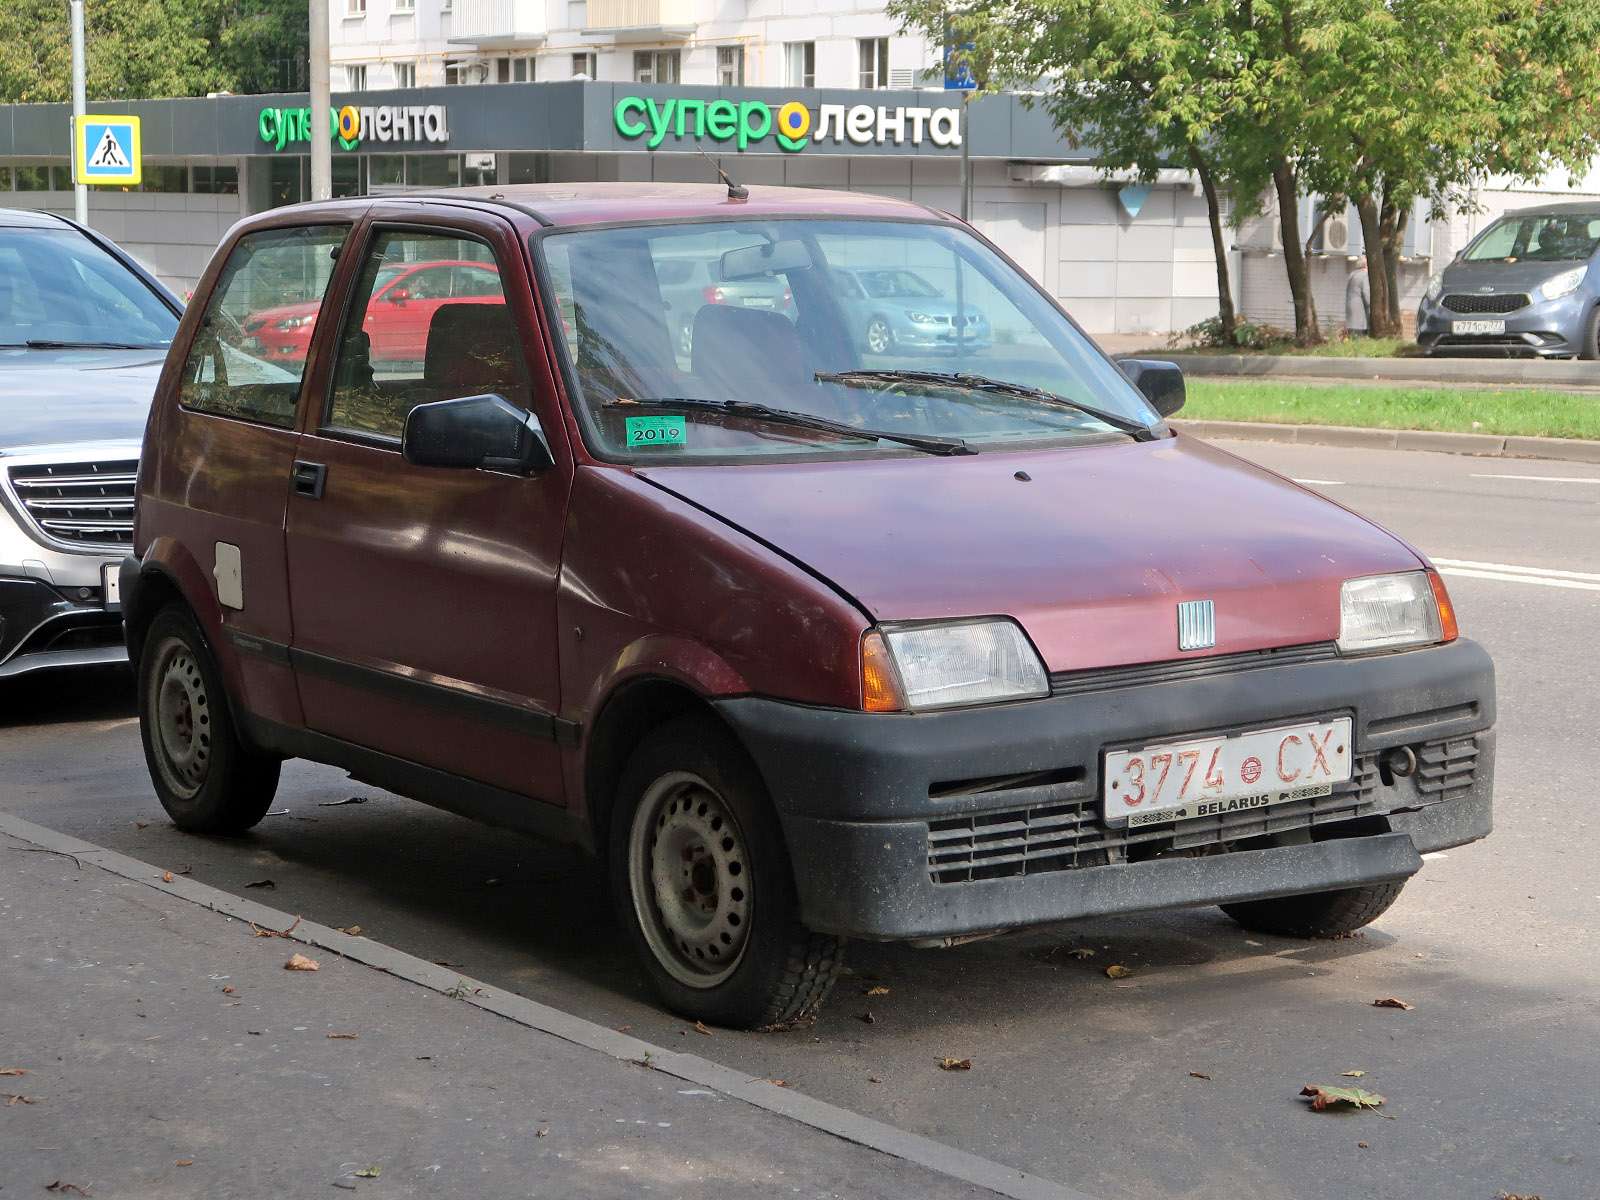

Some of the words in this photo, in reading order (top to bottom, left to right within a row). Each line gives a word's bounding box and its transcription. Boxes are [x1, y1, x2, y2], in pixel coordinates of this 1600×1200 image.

[359, 105, 450, 143] лента
[614, 96, 773, 150] супер
[814, 103, 963, 146] лента
[633, 428, 680, 441] 2019
[1123, 745, 1225, 807] 3774
[1277, 729, 1333, 783] CX
[1197, 794, 1270, 816] BELARUS
